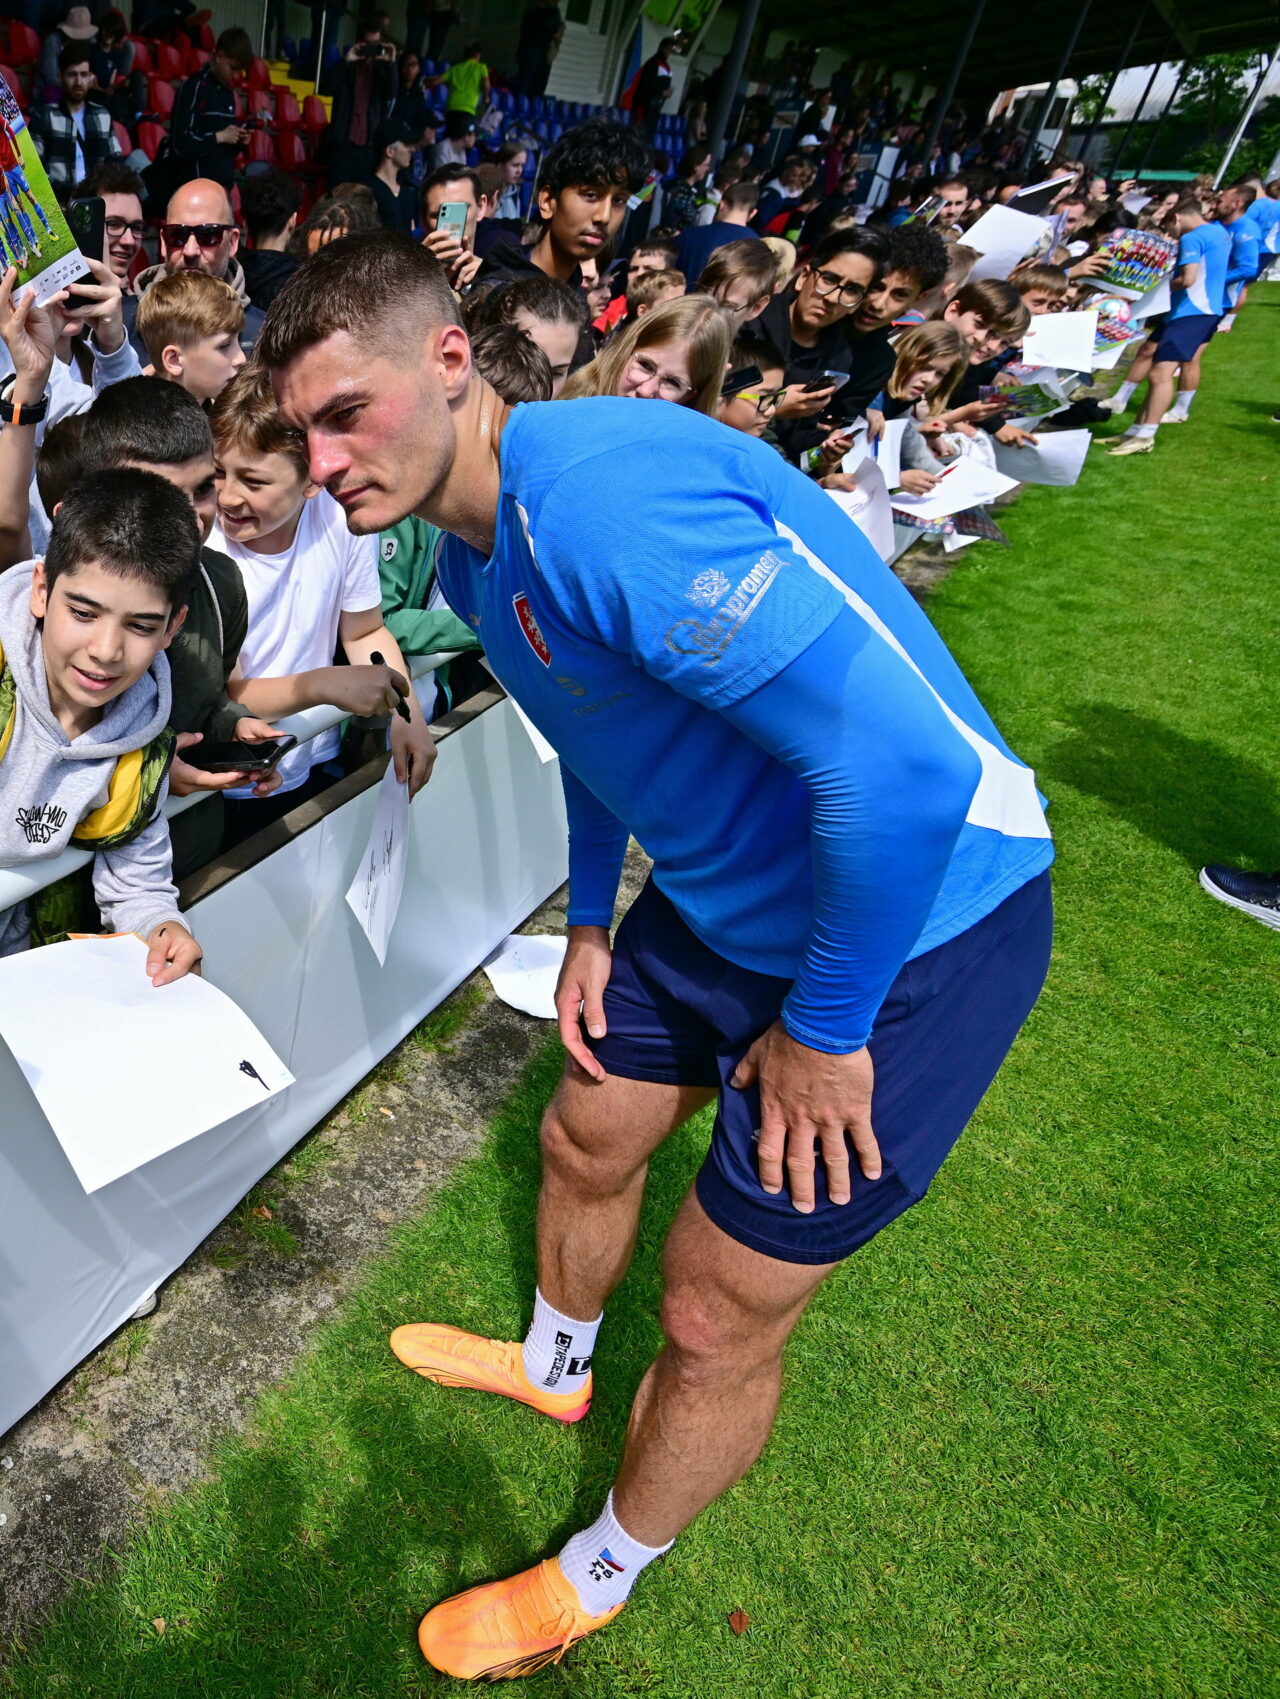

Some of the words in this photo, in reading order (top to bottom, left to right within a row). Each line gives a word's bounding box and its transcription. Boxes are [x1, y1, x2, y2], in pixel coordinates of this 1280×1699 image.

[542, 1345, 568, 1388] TAPEDESIGN
[588, 1569, 601, 1581] 14
[592, 1558, 614, 1578] PS
